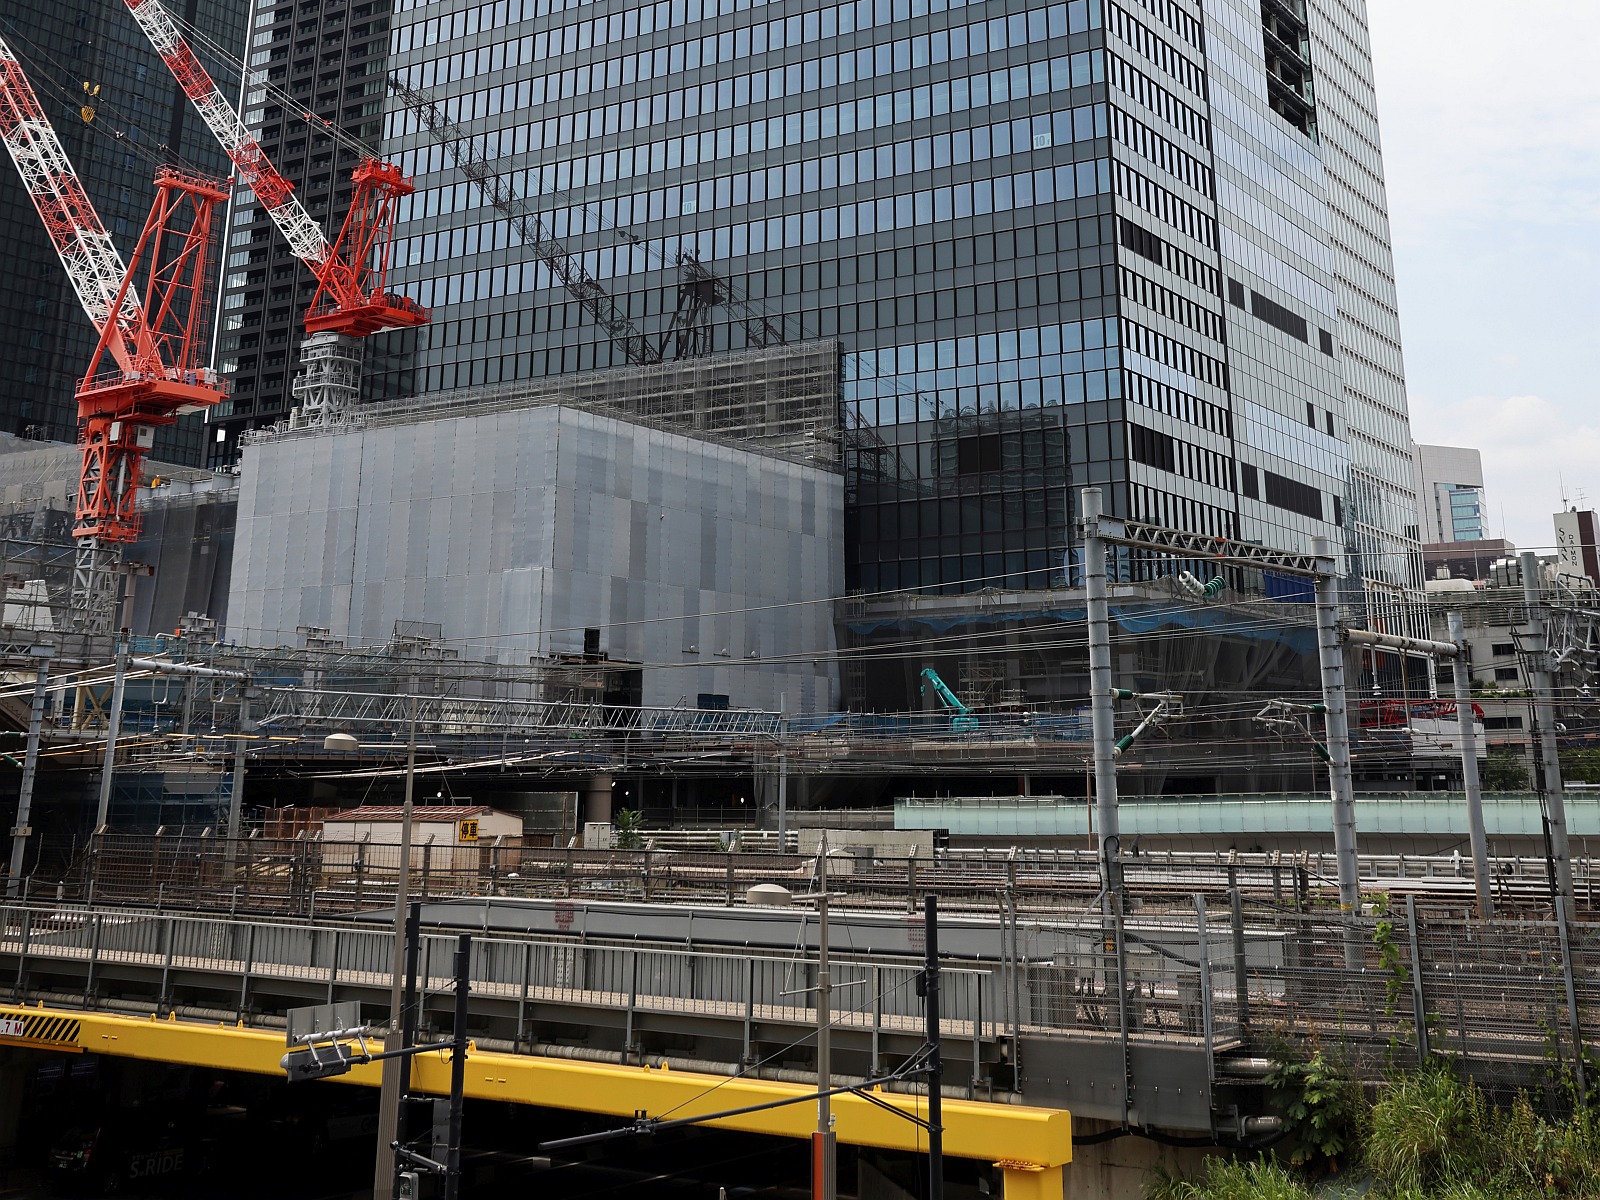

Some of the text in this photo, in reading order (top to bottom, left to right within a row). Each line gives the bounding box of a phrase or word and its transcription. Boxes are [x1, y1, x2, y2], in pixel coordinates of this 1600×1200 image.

[1559, 527, 1568, 561] SVAX
[1568, 534, 1578, 567] DAIMON
[461, 821, 478, 839] 停車
[128, 1153, 184, 1179] S.RIDE
